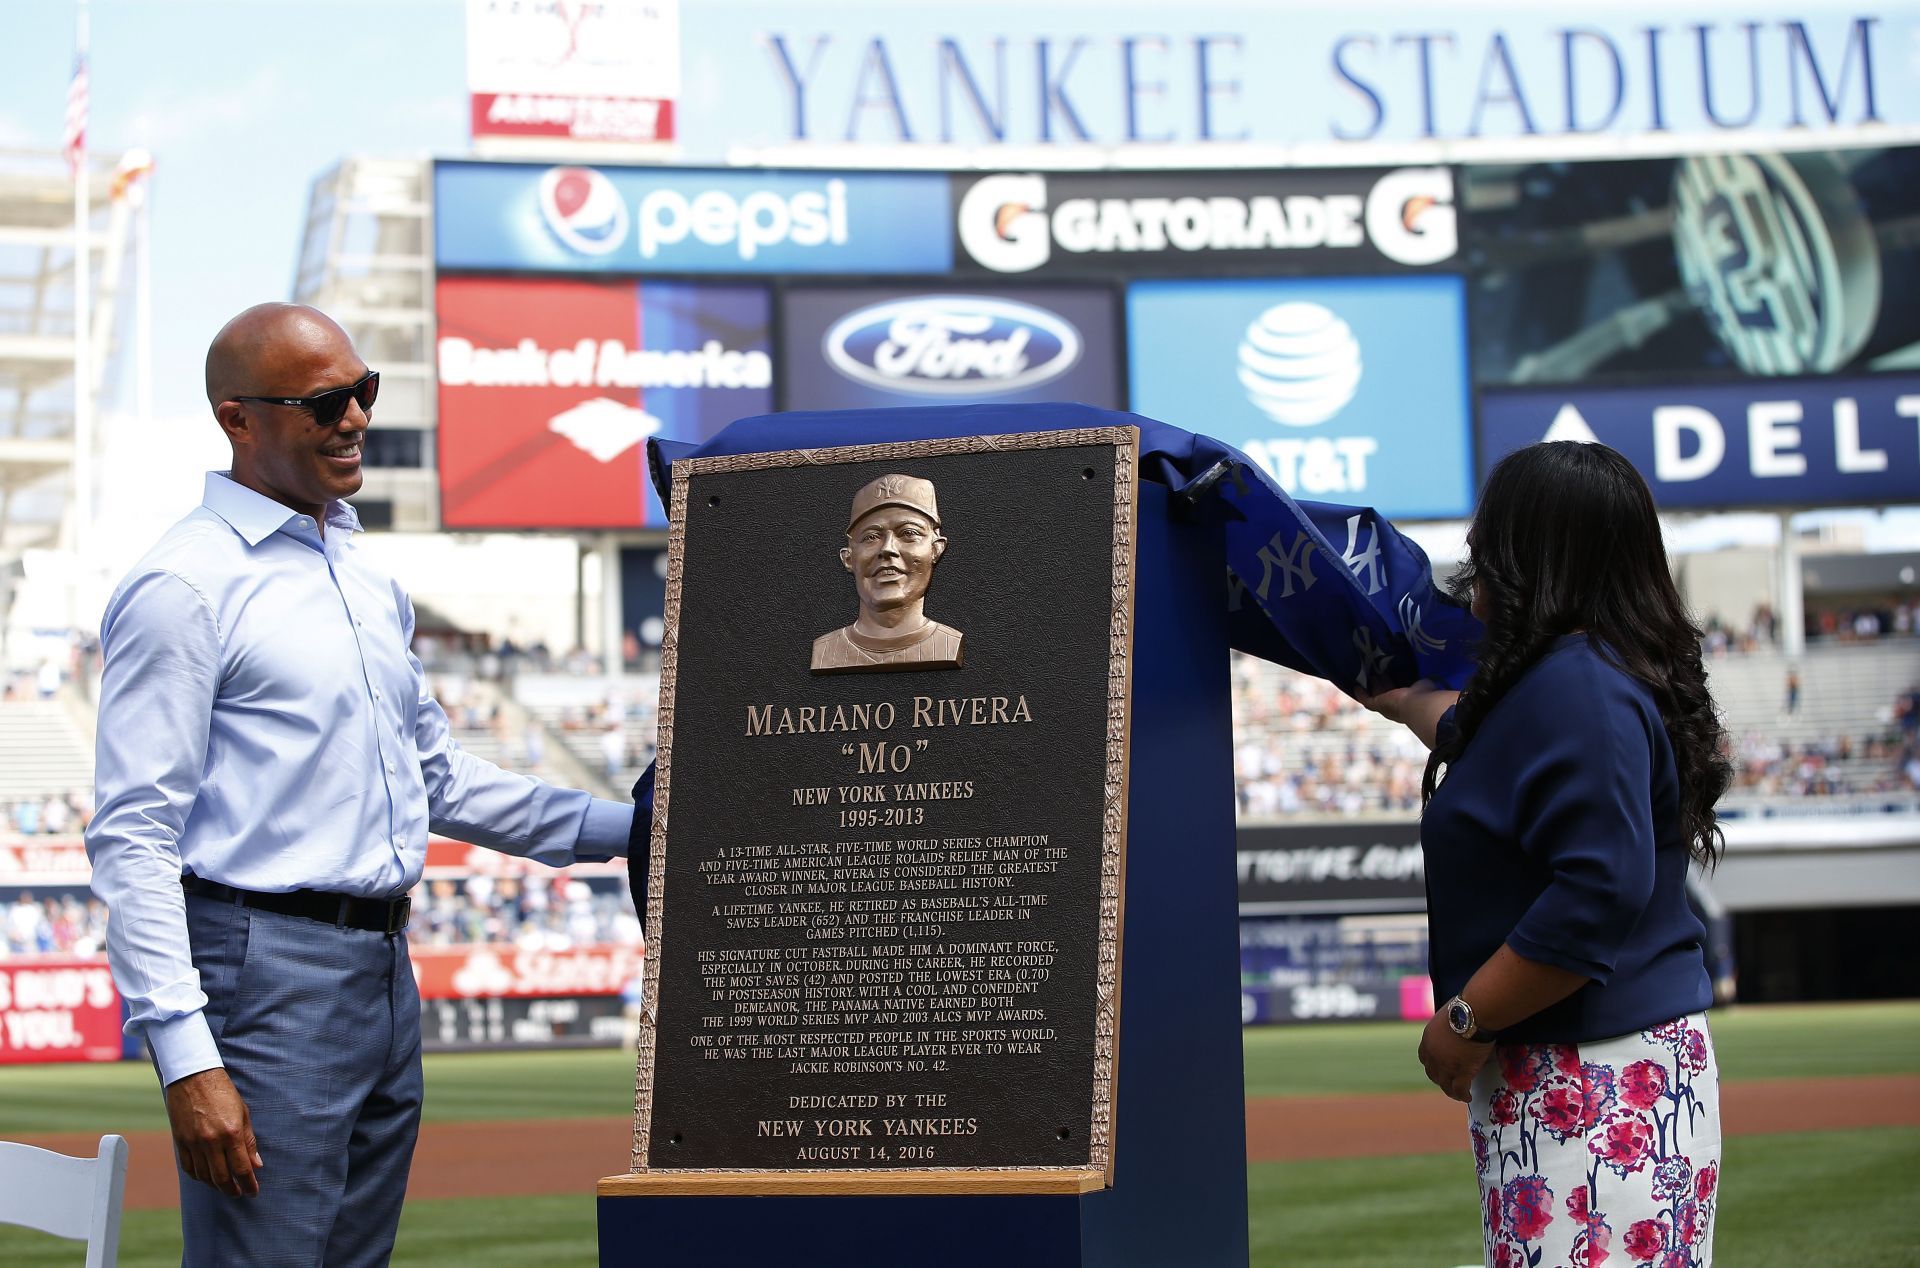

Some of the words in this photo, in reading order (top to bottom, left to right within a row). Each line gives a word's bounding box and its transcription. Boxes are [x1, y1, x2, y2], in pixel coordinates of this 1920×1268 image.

[763, 34, 1249, 143] YANKEE
[1330, 17, 1883, 142] STADIUM
[638, 178, 849, 260] pepsi
[1052, 195, 1364, 252] GATORADE
[874, 311, 1031, 378] Ford
[438, 337, 548, 386] Bank
[549, 338, 597, 387] of
[596, 339, 772, 388] America
[792, 787, 831, 805] NEW
[838, 784, 886, 803] YORK
[893, 780, 973, 801] YANKEES
[839, 807, 923, 827] 1995-2013
[717, 847, 725, 858] A
[730, 845, 771, 857] 13-TIME
[776, 843, 830, 855] ALL-STAR,
[836, 840, 891, 853] FIVE-TIME
[896, 839, 938, 850] WORLD
[942, 837, 981, 849] SERIES
[985, 834, 1048, 847] CHAMPION
[698, 861, 721, 872] AND
[725, 858, 779, 870] FIVE-TIME
[783, 856, 841, 868] AMERICAN
[847, 853, 890, 866] LEAGUE
[895, 852, 945, 864] ROLAIDS
[949, 850, 988, 862] RELIEF
[992, 849, 1019, 860] MAN
[1024, 848, 1039, 859] OF
[1044, 847, 1067, 858] THE
[706, 873, 735, 884] YEAR
[739, 871, 777, 883] AWARD
[781, 869, 828, 881] WINNER,
[879, 867, 889, 878] IS
[894, 864, 966, 877] CONSIDERED
[971, 863, 994, 874] THE
[999, 861, 1058, 874] GREATEST
[744, 884, 787, 896] CLOSER
[791, 883, 803, 894] IN
[807, 882, 846, 893] MAJOR
[851, 880, 894, 892] LEAGUE
[899, 878, 957, 890] BASEBALL
[962, 876, 1014, 888] HISTORY.
[711, 905, 720, 916] A
[723, 903, 773, 915] LIFETIME
[778, 901, 824, 913] YANKEE,
[829, 901, 844, 912] HE
[849, 899, 897, 911] RETIRED
[901, 898, 916, 909] AS
[921, 896, 989, 909] BASEBALL'S
[993, 894, 1047, 906] ALL-TIME
[726, 917, 760, 928] SAVES
[764, 915, 807, 927] LEADER
[811, 914, 839, 928] (652)
[844, 913, 869, 924] AND
[873, 912, 895, 923] THE
[900, 910, 963, 923] FRANCHISE
[968, 909, 1013, 921] LEADER
[1018, 908, 1030, 919] IN
[806, 927, 844, 939] GAMES
[849, 926, 898, 938] PITCHED
[902, 924, 945, 939] (1,115).
[697, 950, 715, 961] HIS
[719, 948, 780, 961] SIGNATURE
[785, 947, 807, 959] CUT
[812, 946, 867, 958] FASTBALL
[872, 944, 904, 956] MADE
[909, 944, 931, 955] HIM
[936, 943, 944, 954] A
[949, 941, 1012, 954] DOMINANT
[1017, 940, 1058, 953] FORCE,
[701, 962, 765, 974] ESPECIALLY
[770, 962, 781, 972] IN
[786, 960, 842, 972] OCTOBER.
[845, 959, 888, 970] DURING
[893, 958, 912, 969] HIS
[916, 956, 965, 968] CAREER,
[970, 956, 985, 967] HE
[990, 954, 1053, 966] RECORDED
[703, 976, 725, 987] THE
[730, 975, 761, 987] MOST
[765, 974, 799, 986] SAVES
[803, 974, 825, 987] (42)
[830, 973, 854, 984] AND
[859, 972, 903, 983] POSTED
[908, 971, 931, 982] THE
[936, 969, 983, 981] LOWEST
[988, 969, 1011, 980] ERA
[1016, 968, 1049, 982] (0.70)
[712, 990, 723, 1000] IN
[728, 988, 799, 1000] POSTSEASON
[805, 986, 855, 998] HISTORY.
[858, 985, 888, 996] WITH
[893, 985, 902, 996] A
[906, 984, 937, 996] COOL
[942, 983, 967, 995] AND
[971, 981, 1038, 994] CONFIDENT
[734, 1001, 799, 1013] DEMEANOR,
[804, 1000, 826, 1011] THE
[832, 999, 879, 1011] PANAMA
[884, 998, 924, 1009] NATIVE
[929, 997, 975, 1008] EARNED
[981, 996, 1013, 1007] BOTH
[702, 1016, 723, 1027] THE
[729, 1015, 752, 1026] 1999
[757, 1014, 797, 1025] WORLD
[802, 1013, 839, 1025] SERIES
[844, 1013, 868, 1024] MVP
[873, 1012, 897, 1023] AND
[902, 1011, 927, 1023] 2003
[932, 1010, 961, 1022] ALCS
[966, 1010, 991, 1021] MVP
[996, 1009, 1047, 1021] AWARDS.
[5, 1010, 84, 1050] YOU.
[690, 1035, 713, 1046] ONE
[717, 1035, 732, 1045] OF
[736, 1034, 759, 1045] THE
[763, 1033, 795, 1045] MOST
[800, 1032, 864, 1044] RESPECTED
[869, 1031, 912, 1043] PEOPLE
[917, 1031, 929, 1042] IN
[934, 1030, 957, 1041] THE
[961, 1029, 1006, 1041] SPORTS
[1011, 1028, 1057, 1041] WORLD,
[704, 1048, 718, 1059] HE
[723, 1048, 746, 1058] WAS
[751, 1047, 773, 1058] THE
[778, 1047, 805, 1058] LAST
[810, 1046, 849, 1057] MAJOR
[854, 1045, 898, 1056] LEAGUE
[903, 1044, 946, 1055] PLAYER
[951, 1043, 981, 1055] EVER
[985, 1043, 1002, 1054] TO
[1007, 1042, 1041, 1053] WEAR
[790, 1062, 828, 1073] JACKIE
[833, 1060, 902, 1072] ROBINSON'S
[907, 1060, 928, 1071] NO.
[932, 1060, 949, 1071] 42.
[789, 1095, 878, 1108] DEDICATED
[886, 1094, 907, 1107] BY
[914, 1093, 946, 1106] THE
[757, 1120, 804, 1136] NEW
[814, 1119, 872, 1136] YORK
[882, 1117, 977, 1135] YANKEES
[796, 1146, 860, 1159] AUGUST
[870, 1146, 890, 1160] 14,
[899, 1145, 934, 1159] 2016
